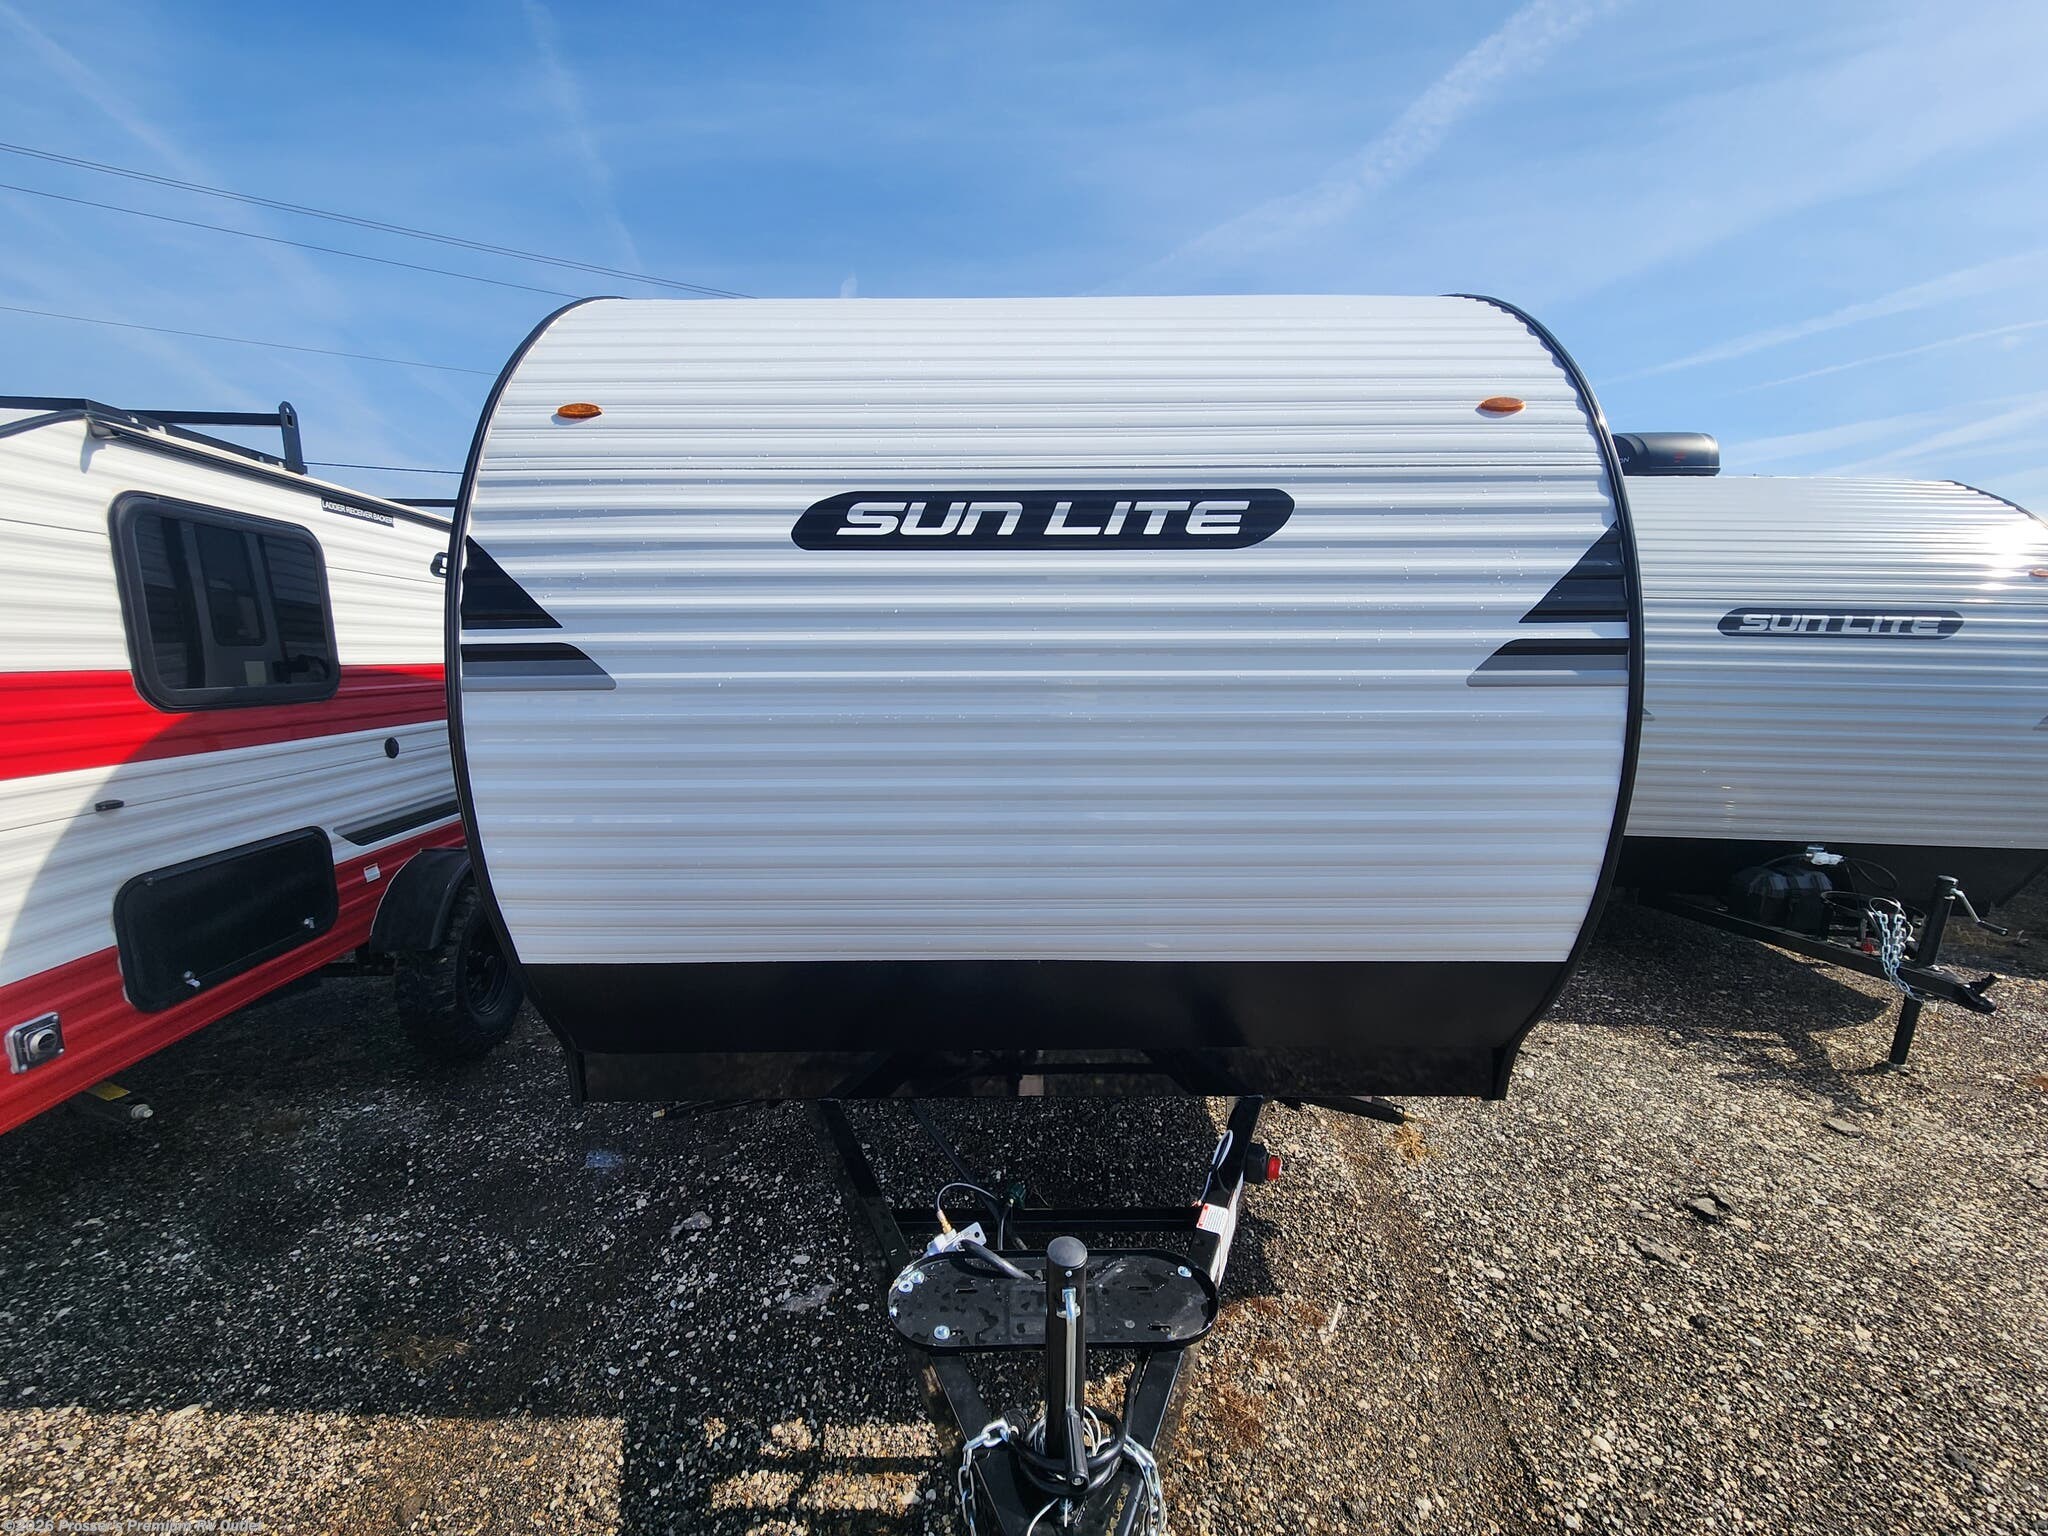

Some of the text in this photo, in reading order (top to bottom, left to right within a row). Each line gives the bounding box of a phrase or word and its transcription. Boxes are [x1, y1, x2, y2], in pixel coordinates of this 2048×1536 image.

[323, 501, 345, 512] LADDER
[346, 506, 373, 519] RECEIVER
[836, 500, 1251, 537] SUN LITE
[1739, 613, 1943, 634] SUN LITE
